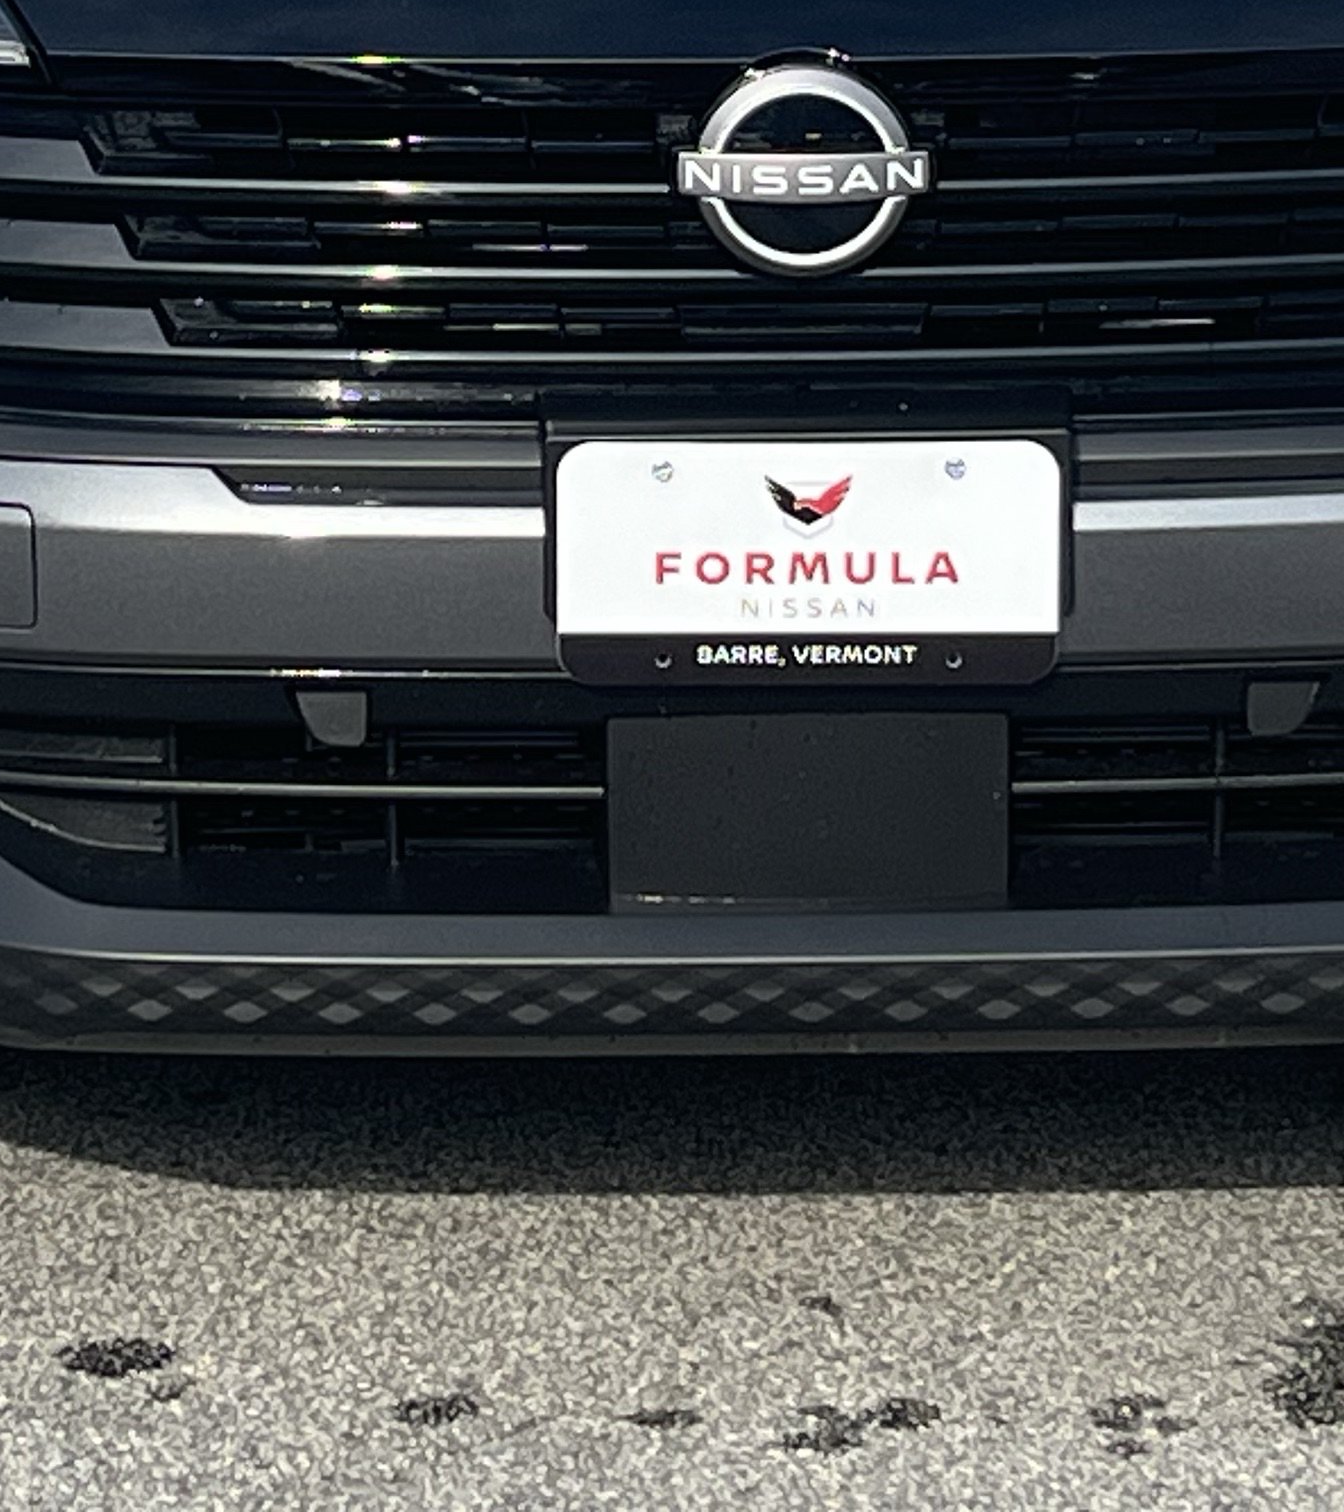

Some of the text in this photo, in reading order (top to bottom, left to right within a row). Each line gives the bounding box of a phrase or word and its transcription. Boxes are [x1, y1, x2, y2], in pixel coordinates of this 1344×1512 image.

[684, 158, 925, 195] NISSAN
[655, 551, 959, 585] FORMULA
[740, 598, 876, 618] NISSAN
[696, 645, 917, 667] BARRE, VERMONT
